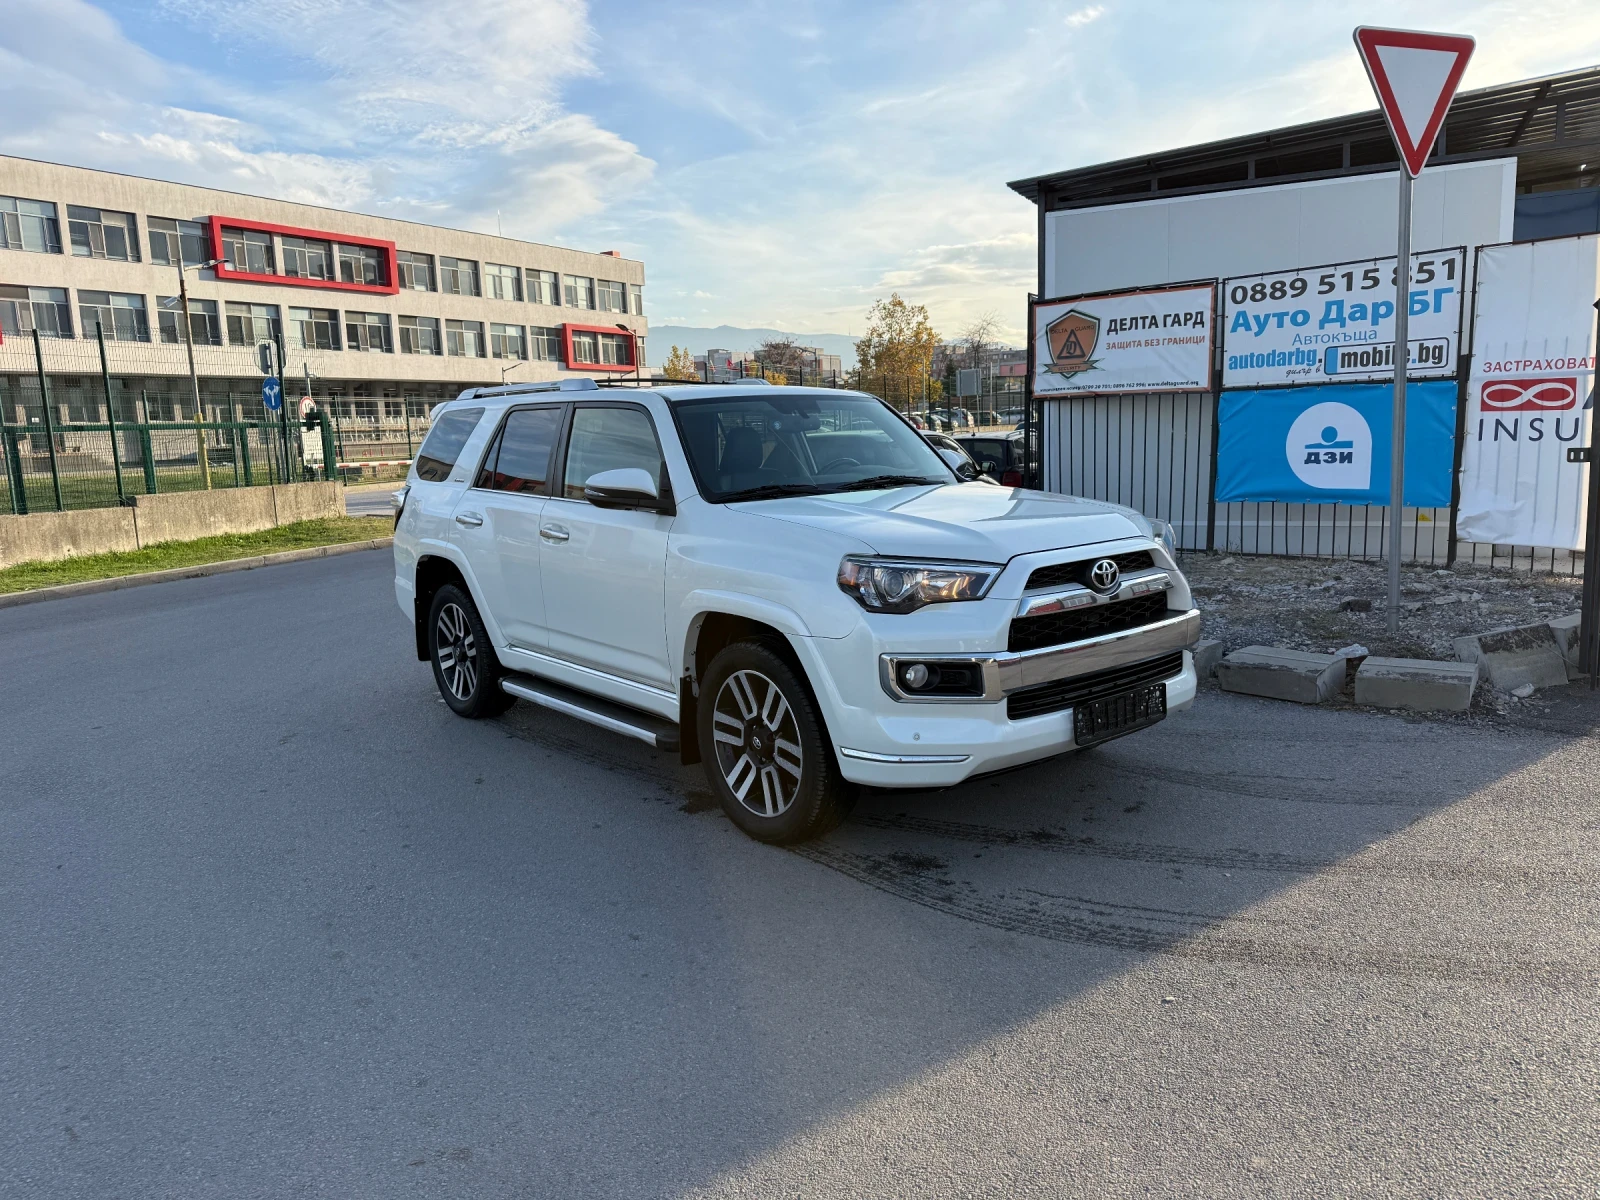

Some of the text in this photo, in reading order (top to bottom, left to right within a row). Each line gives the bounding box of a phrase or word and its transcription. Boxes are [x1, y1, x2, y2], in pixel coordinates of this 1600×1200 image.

[1230, 277, 1308, 304] 0889
[1317, 268, 1380, 294] 515
[1230, 287, 1454, 337] Ауто Дар БГ
[1106, 311, 1205, 335] ДЕЛТА ГАРД
[1106, 335, 1206, 351] ЗАЩИТА БЕЗ ГРАНИЦИ
[1292, 329, 1377, 346] Автокъща
[1286, 366, 1312, 378] дилър
[1483, 356, 1597, 373] ЗАСТРАХОВАТ
[1478, 417, 1580, 442] INSU
[1304, 451, 1353, 465] ДЗИ
